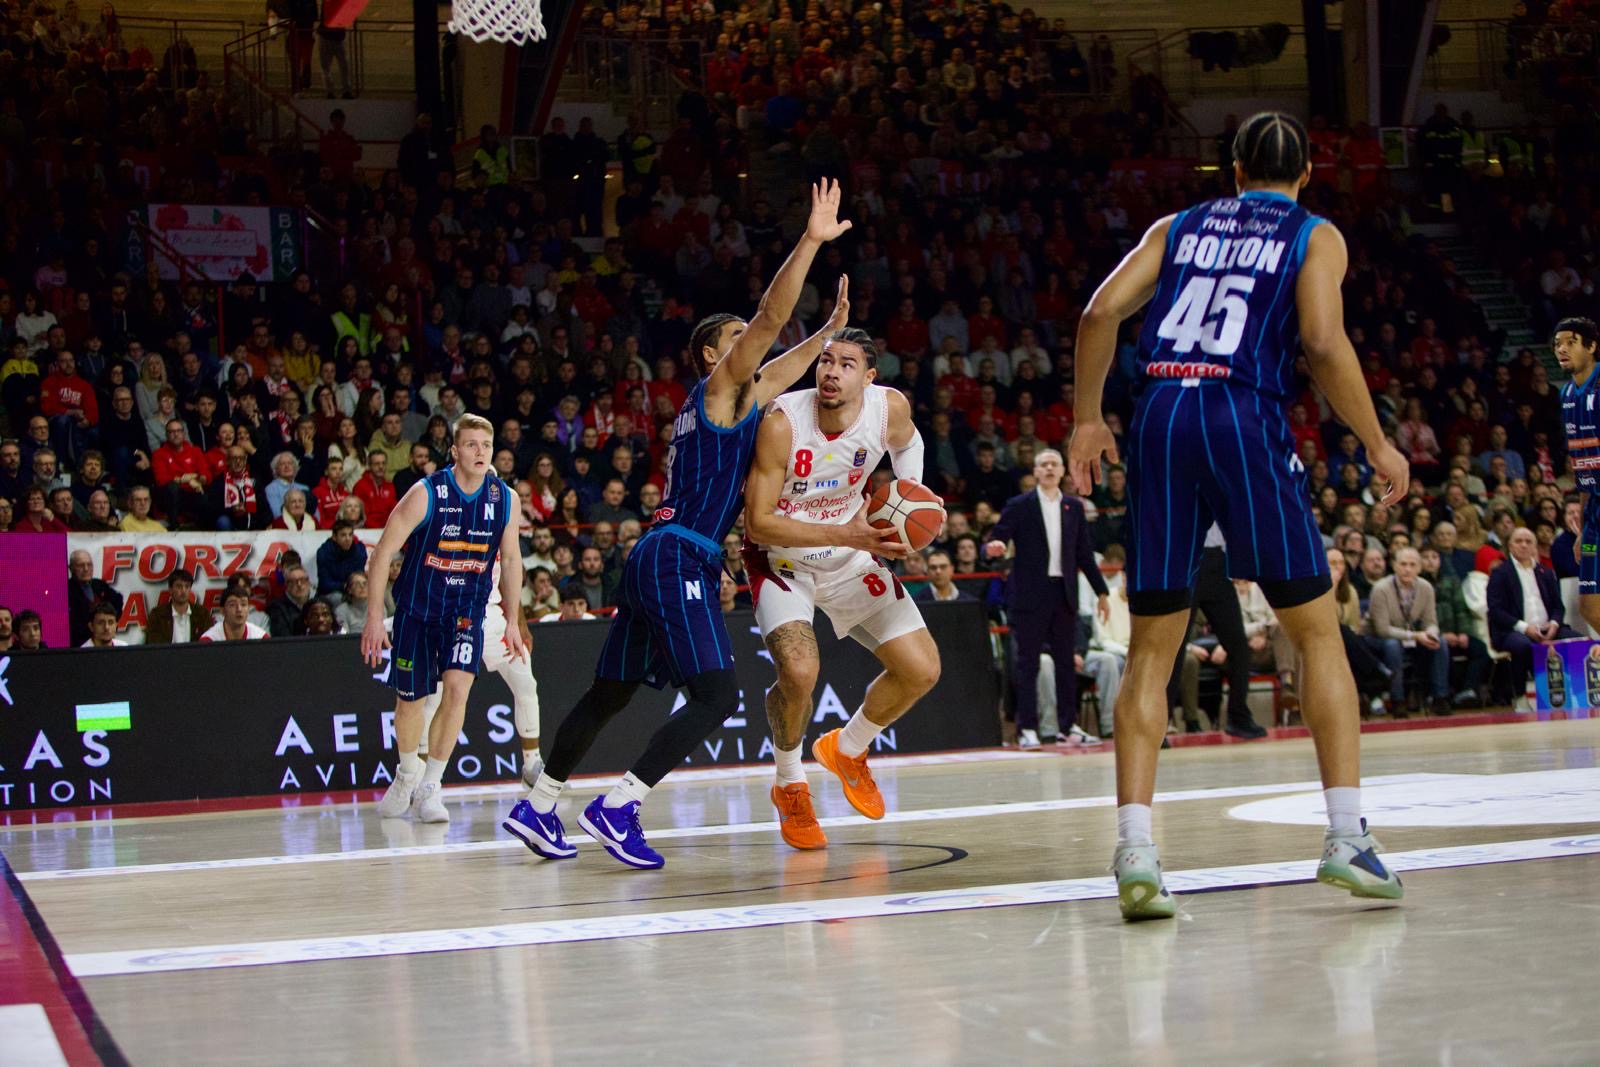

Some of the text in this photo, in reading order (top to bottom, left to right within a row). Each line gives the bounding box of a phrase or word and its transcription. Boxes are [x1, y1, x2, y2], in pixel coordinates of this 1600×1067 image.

[277, 213, 295, 263] BAR
[1173, 233, 1286, 274] BOLTON
[1157, 274, 1256, 356] 45
[794, 448, 813, 478] 8
[436, 484, 449, 499] 18
[484, 503, 494, 520] N
[102, 541, 292, 583] FORZA
[685, 580, 702, 600] N
[863, 573, 886, 597] 8
[452, 642, 473, 665] 18
[275, 704, 514, 756] AERS
[0, 729, 110, 771] AS
[279, 753, 518, 790] AVIAON
[0, 778, 112, 805] TION
